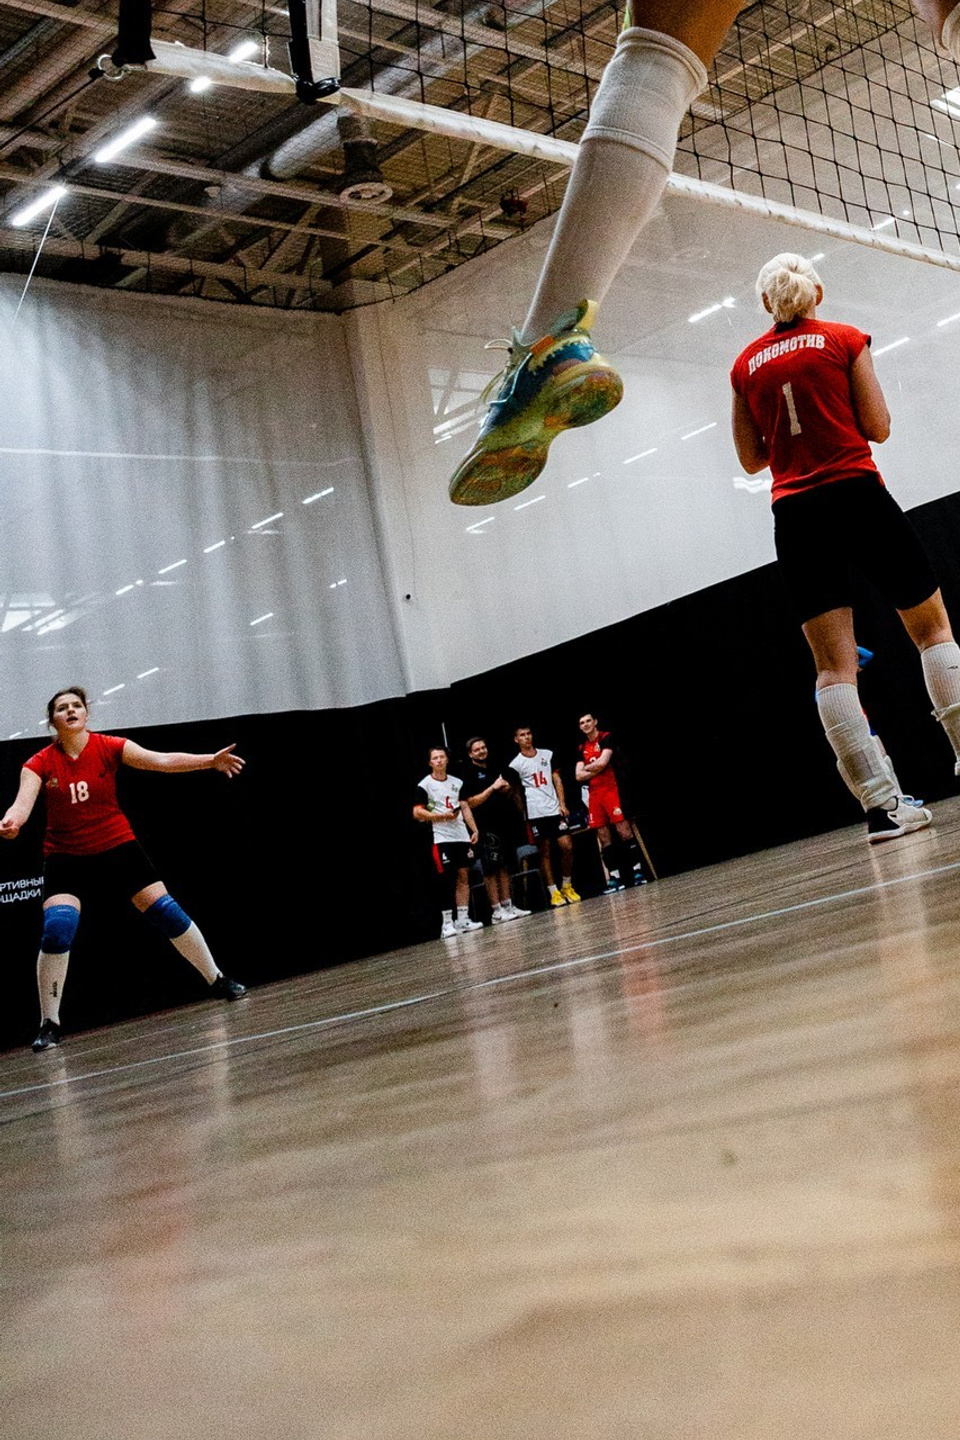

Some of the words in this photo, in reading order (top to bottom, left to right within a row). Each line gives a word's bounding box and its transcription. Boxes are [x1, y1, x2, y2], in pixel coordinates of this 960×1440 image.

[748, 333, 825, 376] ЛОКОМОТИВ
[781, 381, 802, 436] 1
[532, 770, 548, 788] 14
[69, 781, 89, 804] 18
[0, 876, 44, 892] РТИВНЫ
[0, 888, 41, 904] ЩАДКИ
